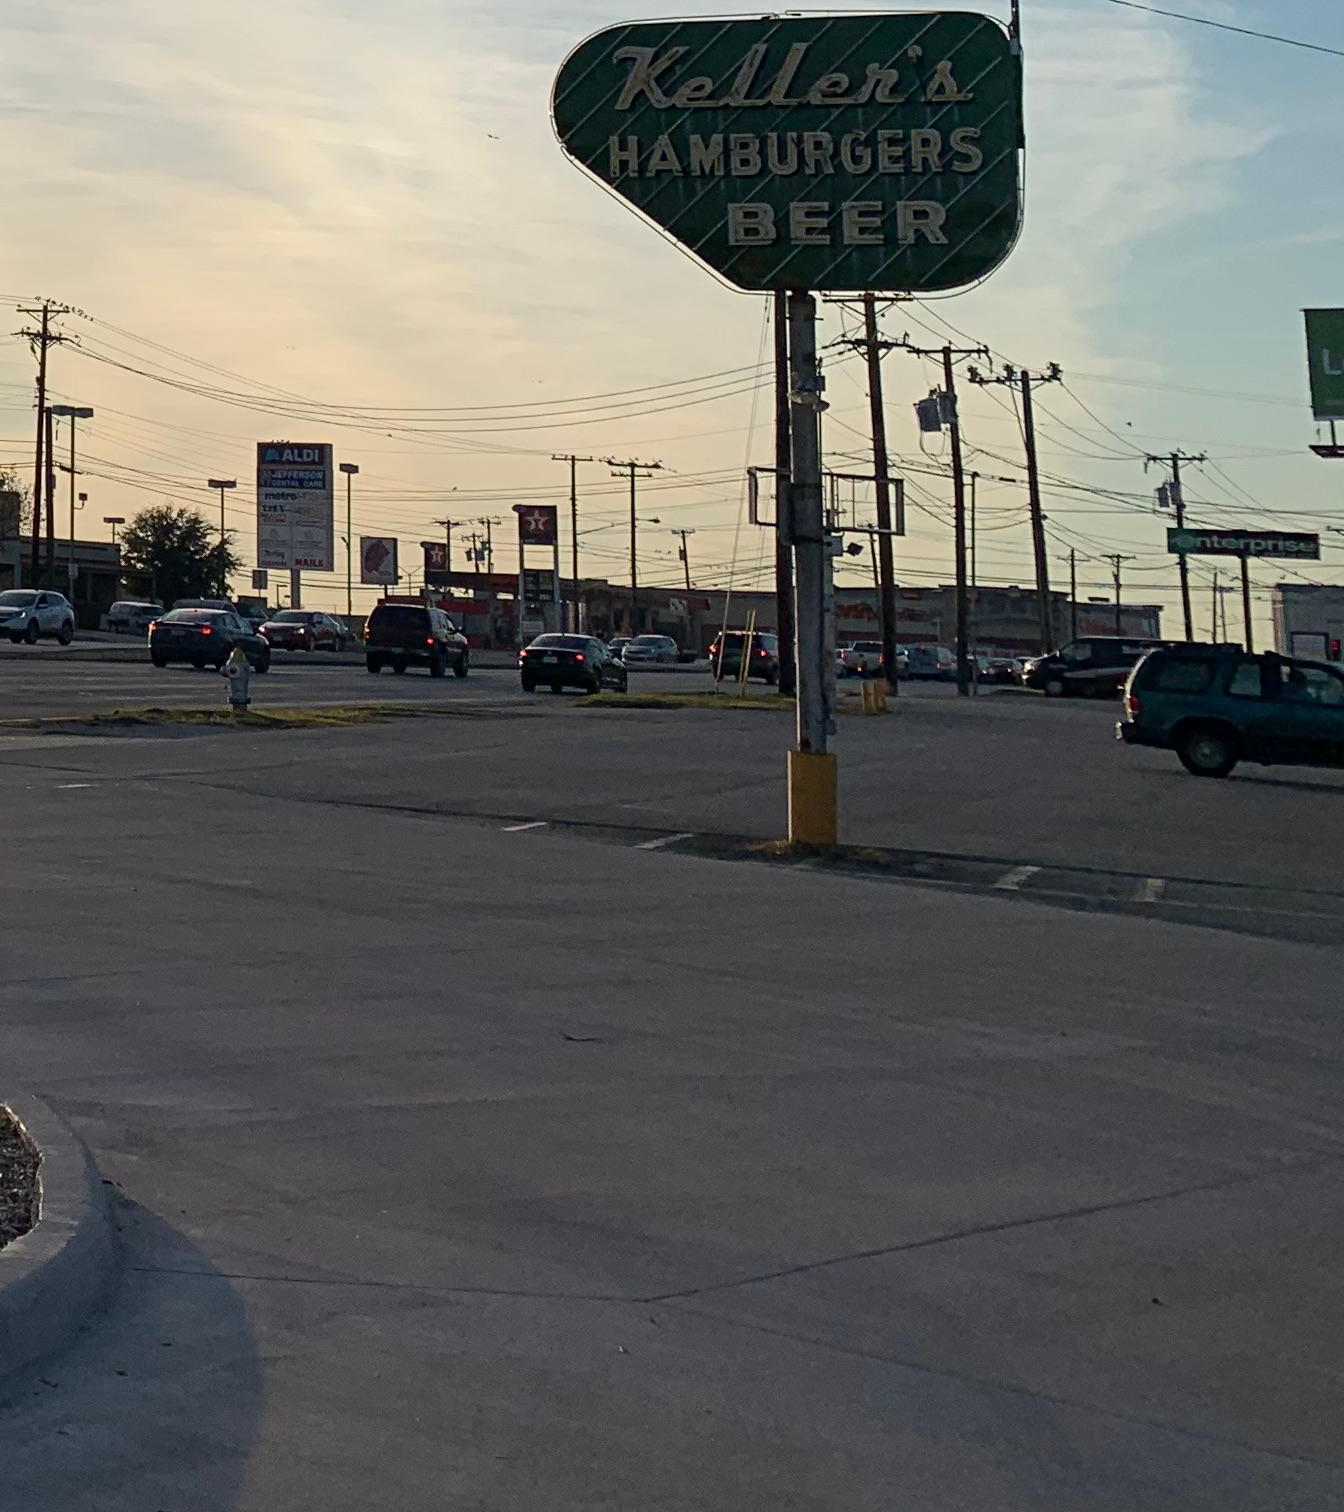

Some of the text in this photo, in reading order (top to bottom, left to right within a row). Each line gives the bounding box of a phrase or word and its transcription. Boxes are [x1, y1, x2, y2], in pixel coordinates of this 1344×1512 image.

[612, 42, 974, 111] Keller's
[610, 127, 984, 178] HAMBURGERS
[728, 200, 949, 246] BEER
[282, 449, 319, 462] ALDI
[1174, 534, 1315, 553] enterprise
